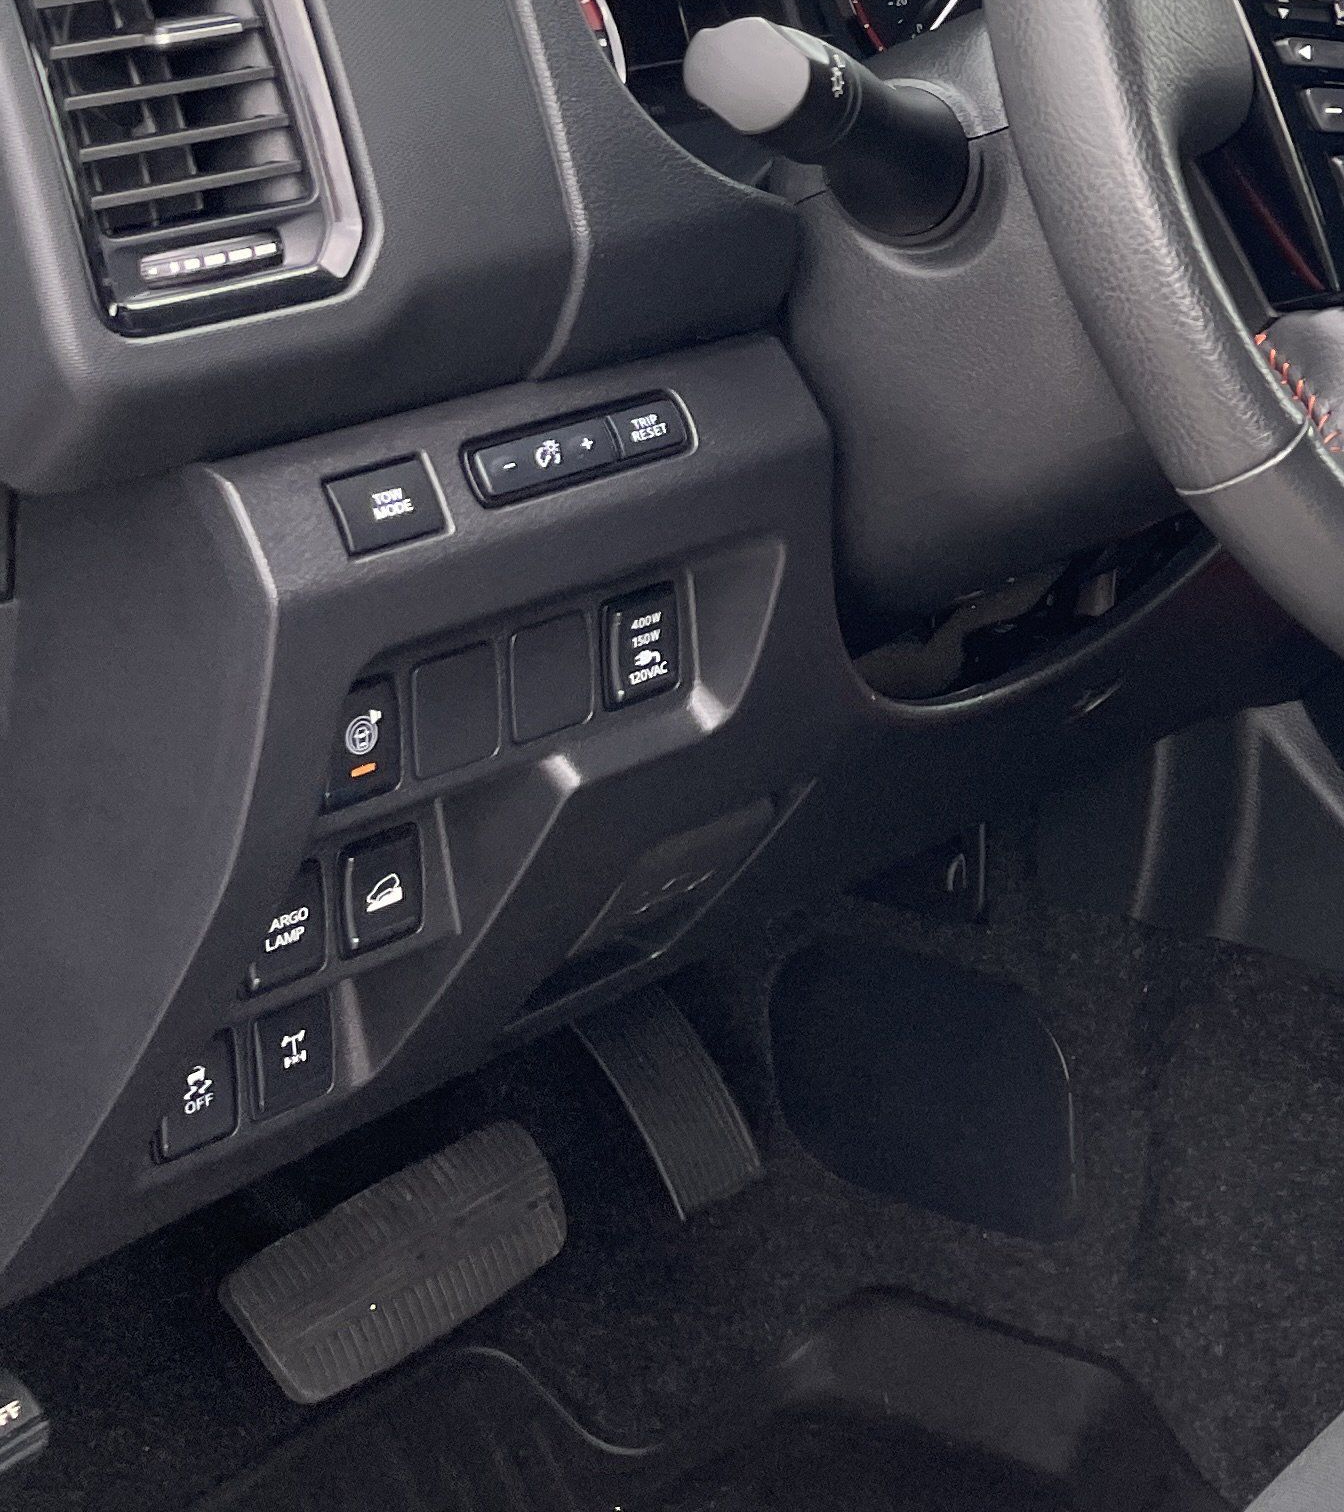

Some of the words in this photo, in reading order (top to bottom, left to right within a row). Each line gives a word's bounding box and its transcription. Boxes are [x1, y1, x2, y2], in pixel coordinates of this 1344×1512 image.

[630, 414, 659, 431] TRIP
[631, 422, 668, 443] RESET
[371, 488, 402, 506] TOW
[372, 499, 414, 521] MODE
[630, 612, 662, 631] 400W
[632, 629, 661, 648] 150W
[628, 661, 669, 686] 120VAC
[265, 926, 305, 953] LAMP
[184, 1092, 214, 1115] OFF
